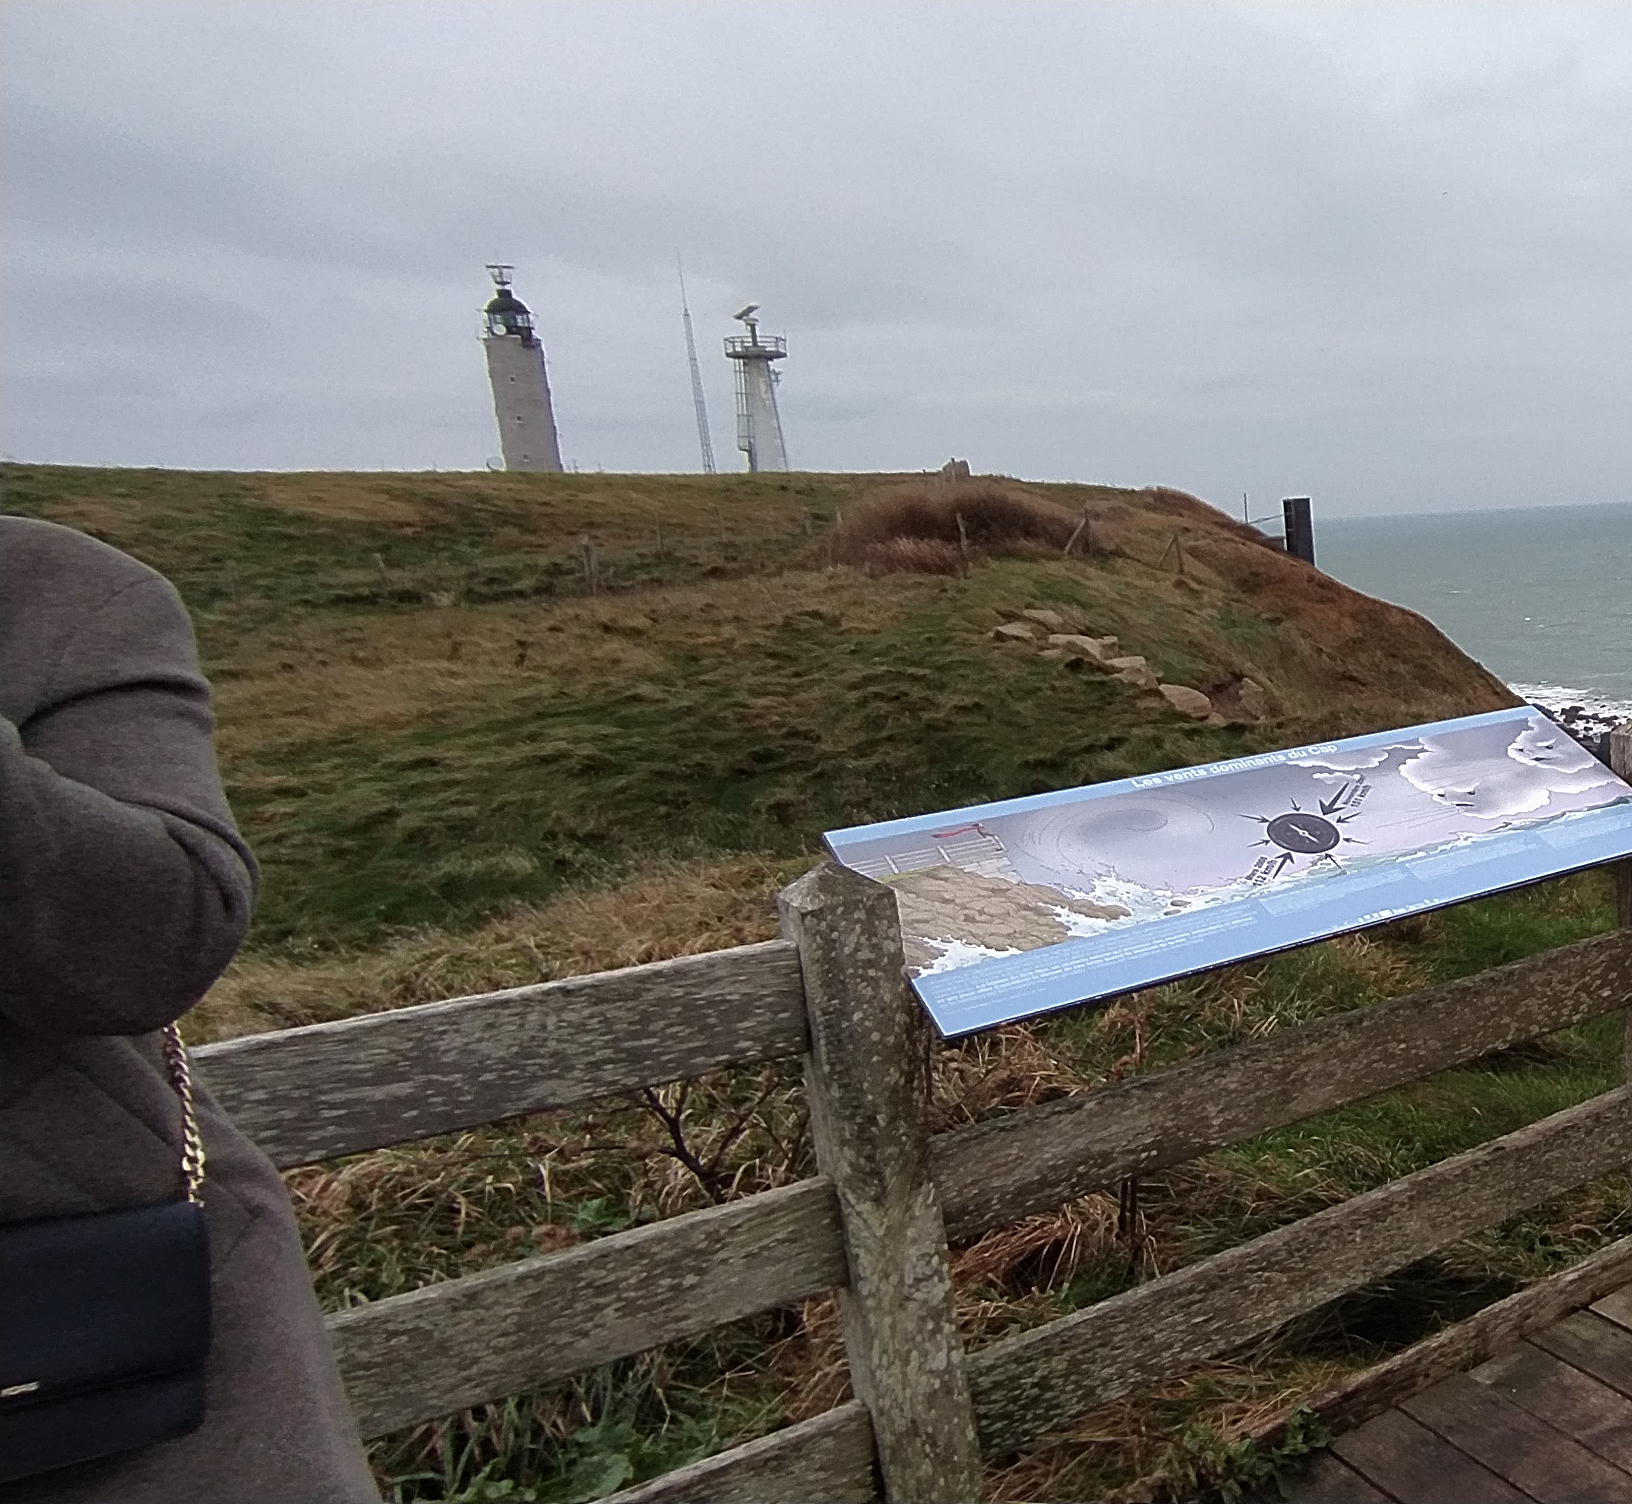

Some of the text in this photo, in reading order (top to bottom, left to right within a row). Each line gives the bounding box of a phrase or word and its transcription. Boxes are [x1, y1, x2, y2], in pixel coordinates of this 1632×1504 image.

[1131, 743, 1338, 789] Les vents dominants du Cap
